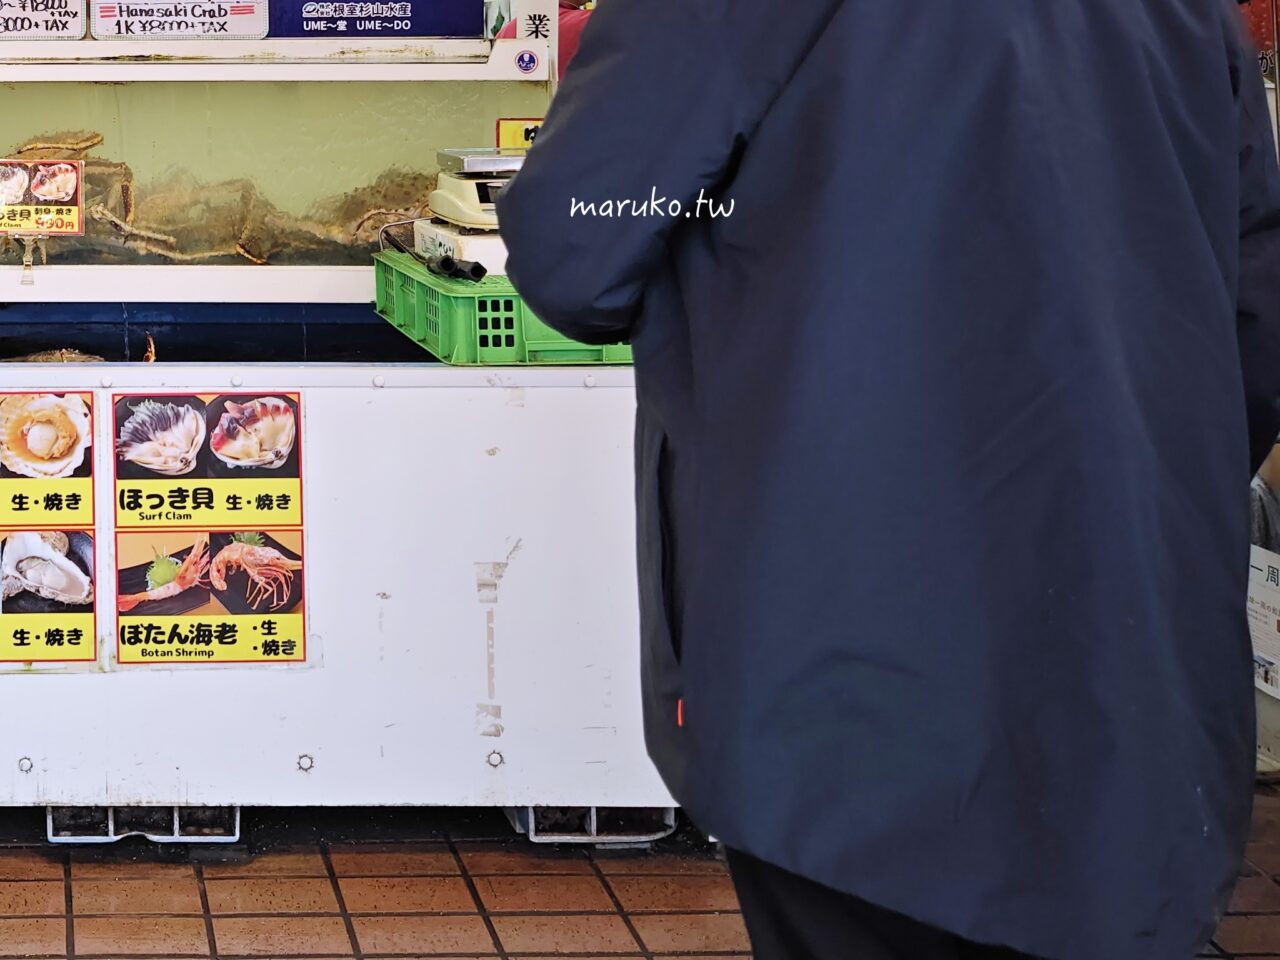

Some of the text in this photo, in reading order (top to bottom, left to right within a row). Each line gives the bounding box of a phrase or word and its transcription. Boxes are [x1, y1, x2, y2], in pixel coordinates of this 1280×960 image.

[119, 4, 228, 18] Hanasaki Crab
[333, 3, 411, 16] 根室杉山水産
[119, 487, 215, 510] ほっき貝
[138, 511, 193, 521] Surf Clam
[119, 623, 239, 646] ぼたん海老
[140, 647, 215, 659] Botan Shrimp
